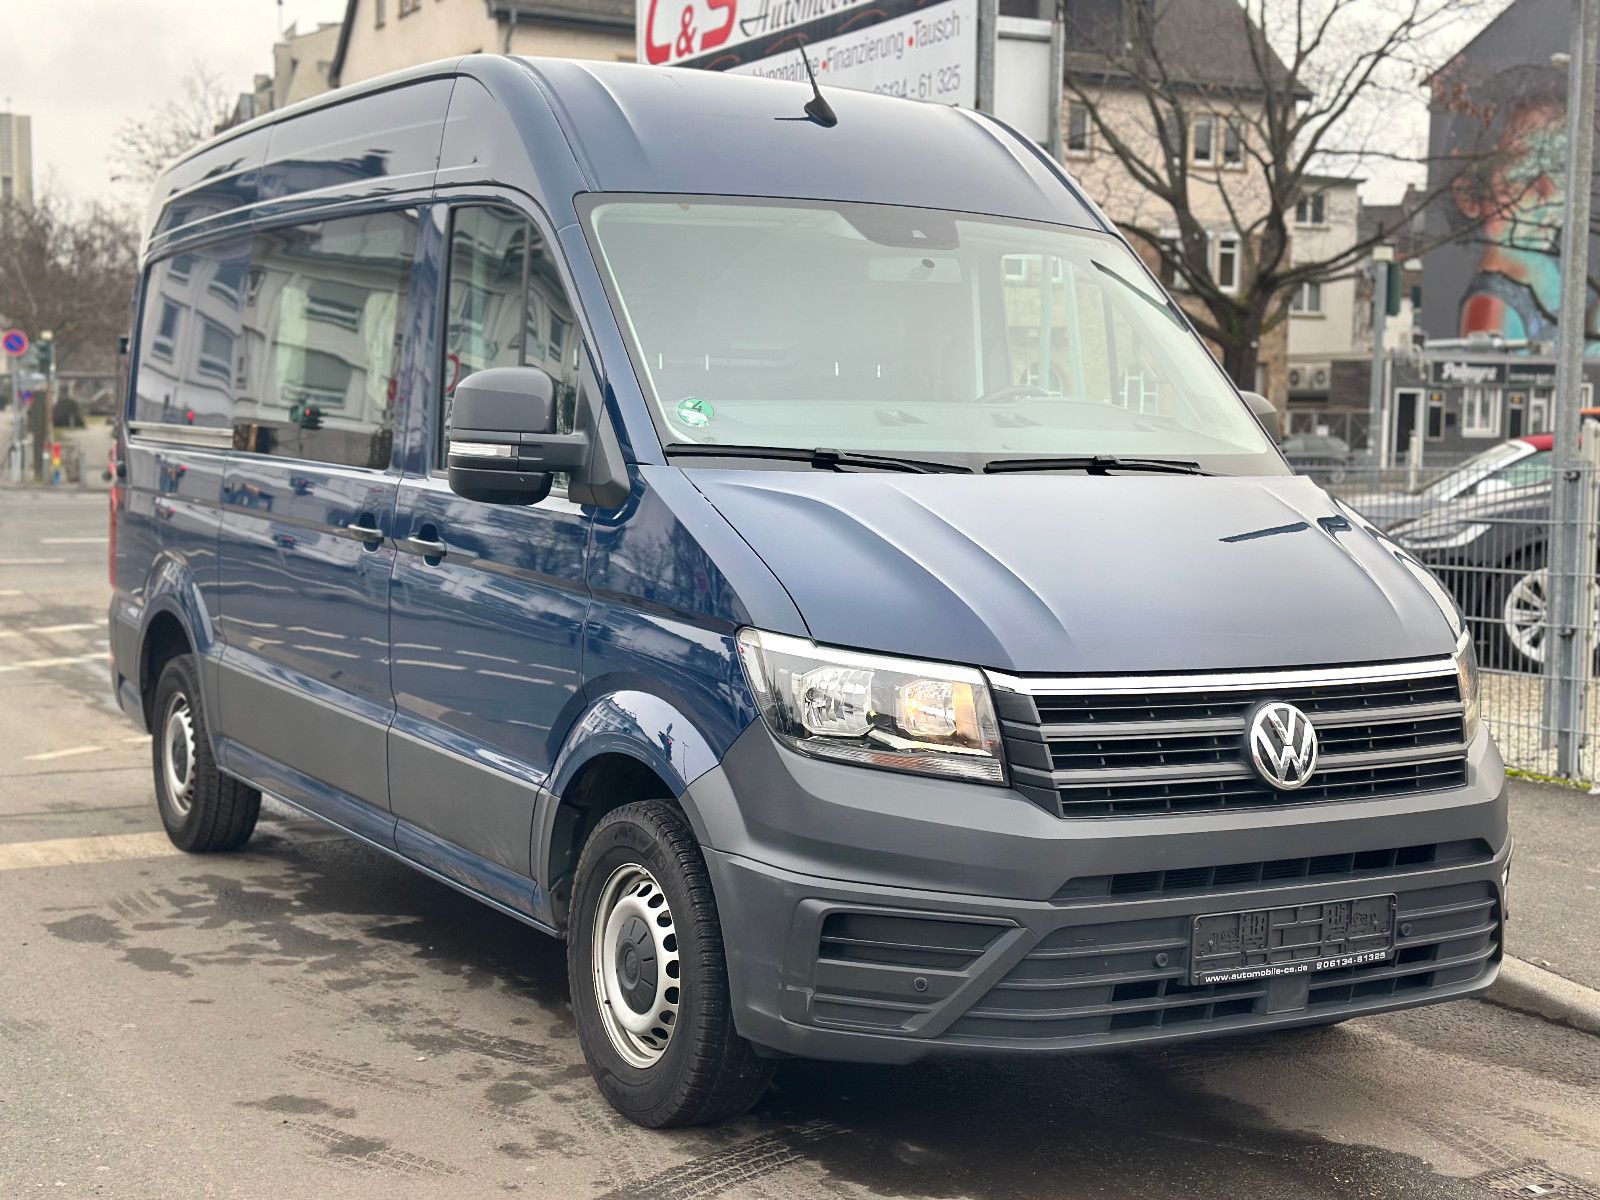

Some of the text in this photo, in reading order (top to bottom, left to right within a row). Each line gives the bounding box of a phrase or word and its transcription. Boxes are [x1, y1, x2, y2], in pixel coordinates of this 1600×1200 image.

[740, 0, 858, 36] Automo
[827, 32, 904, 73] Finanzierung
[913, 10, 960, 48] Tausch
[919, 71, 932, 98] 61
[937, 64, 960, 94] 325
